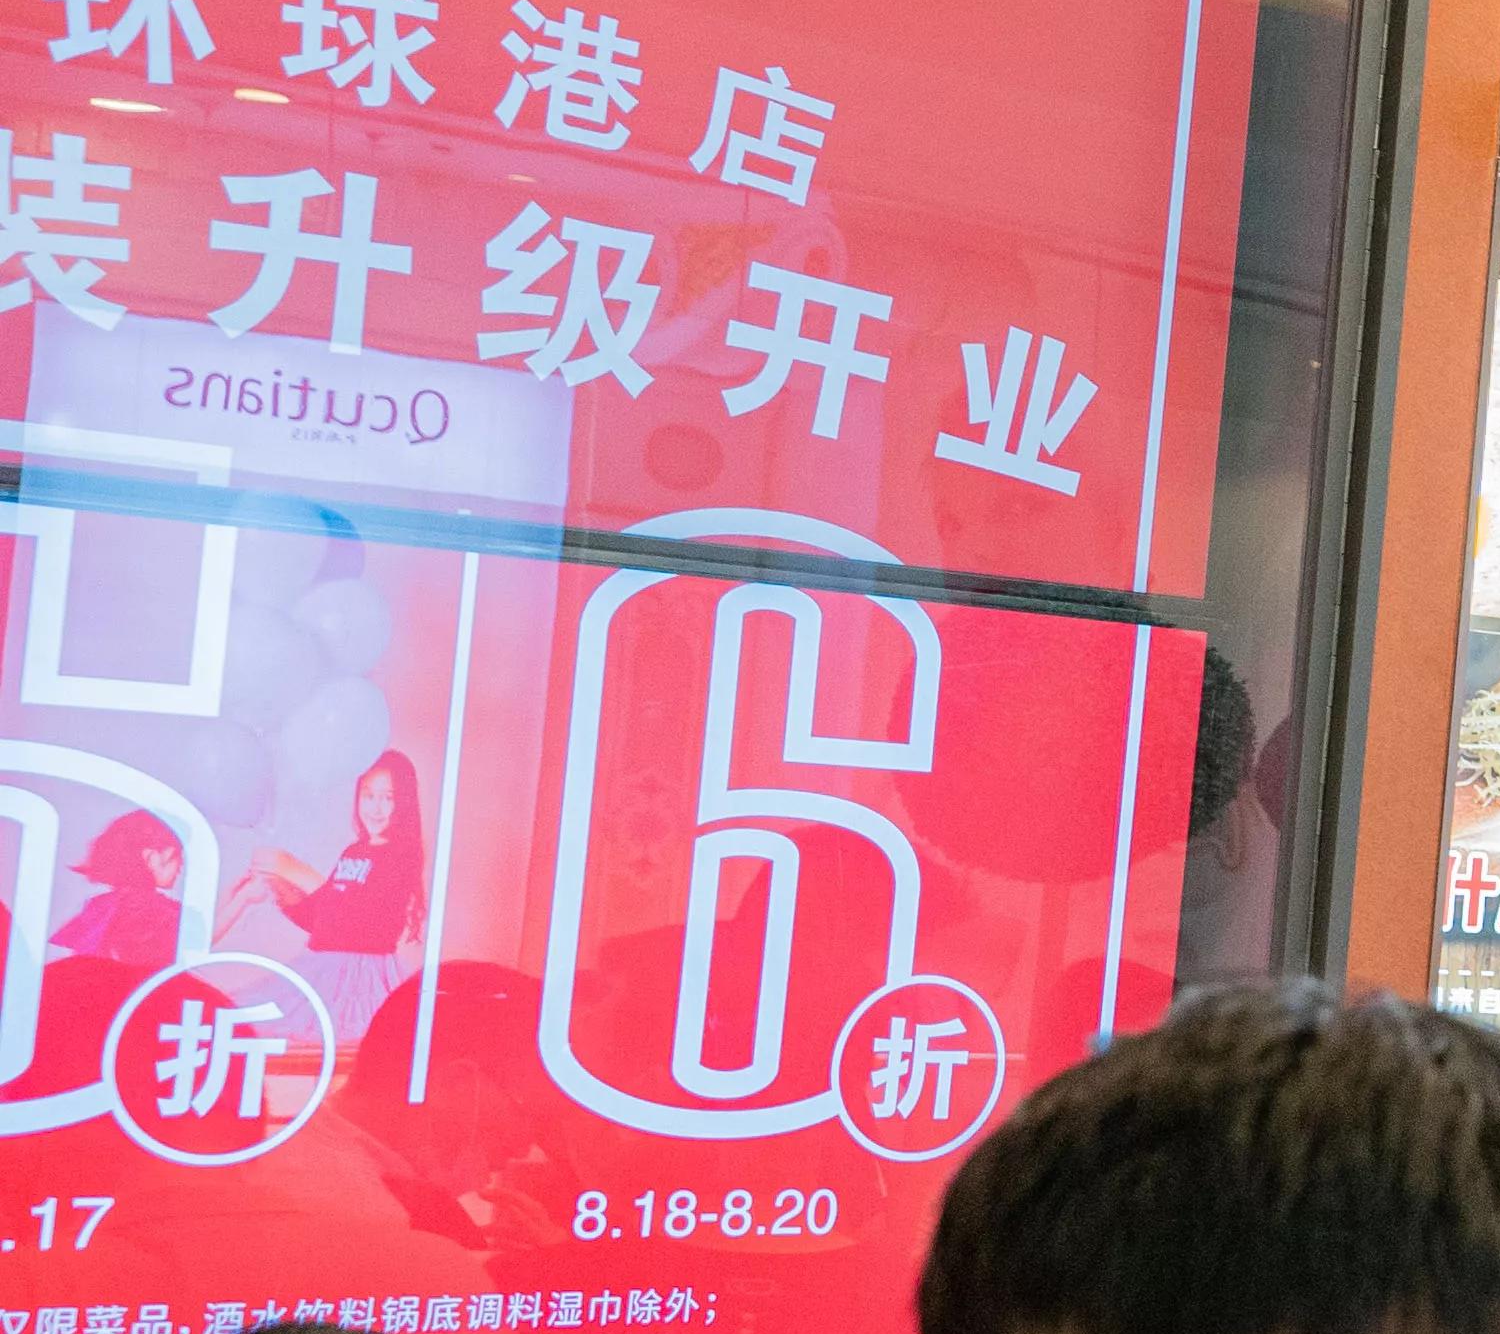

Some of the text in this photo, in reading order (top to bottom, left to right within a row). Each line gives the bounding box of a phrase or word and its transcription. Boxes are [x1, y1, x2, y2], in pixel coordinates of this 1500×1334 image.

[0, 131, 1098, 498] 装升级开业
[572, 1188, 838, 1240] 8.18-8.20
